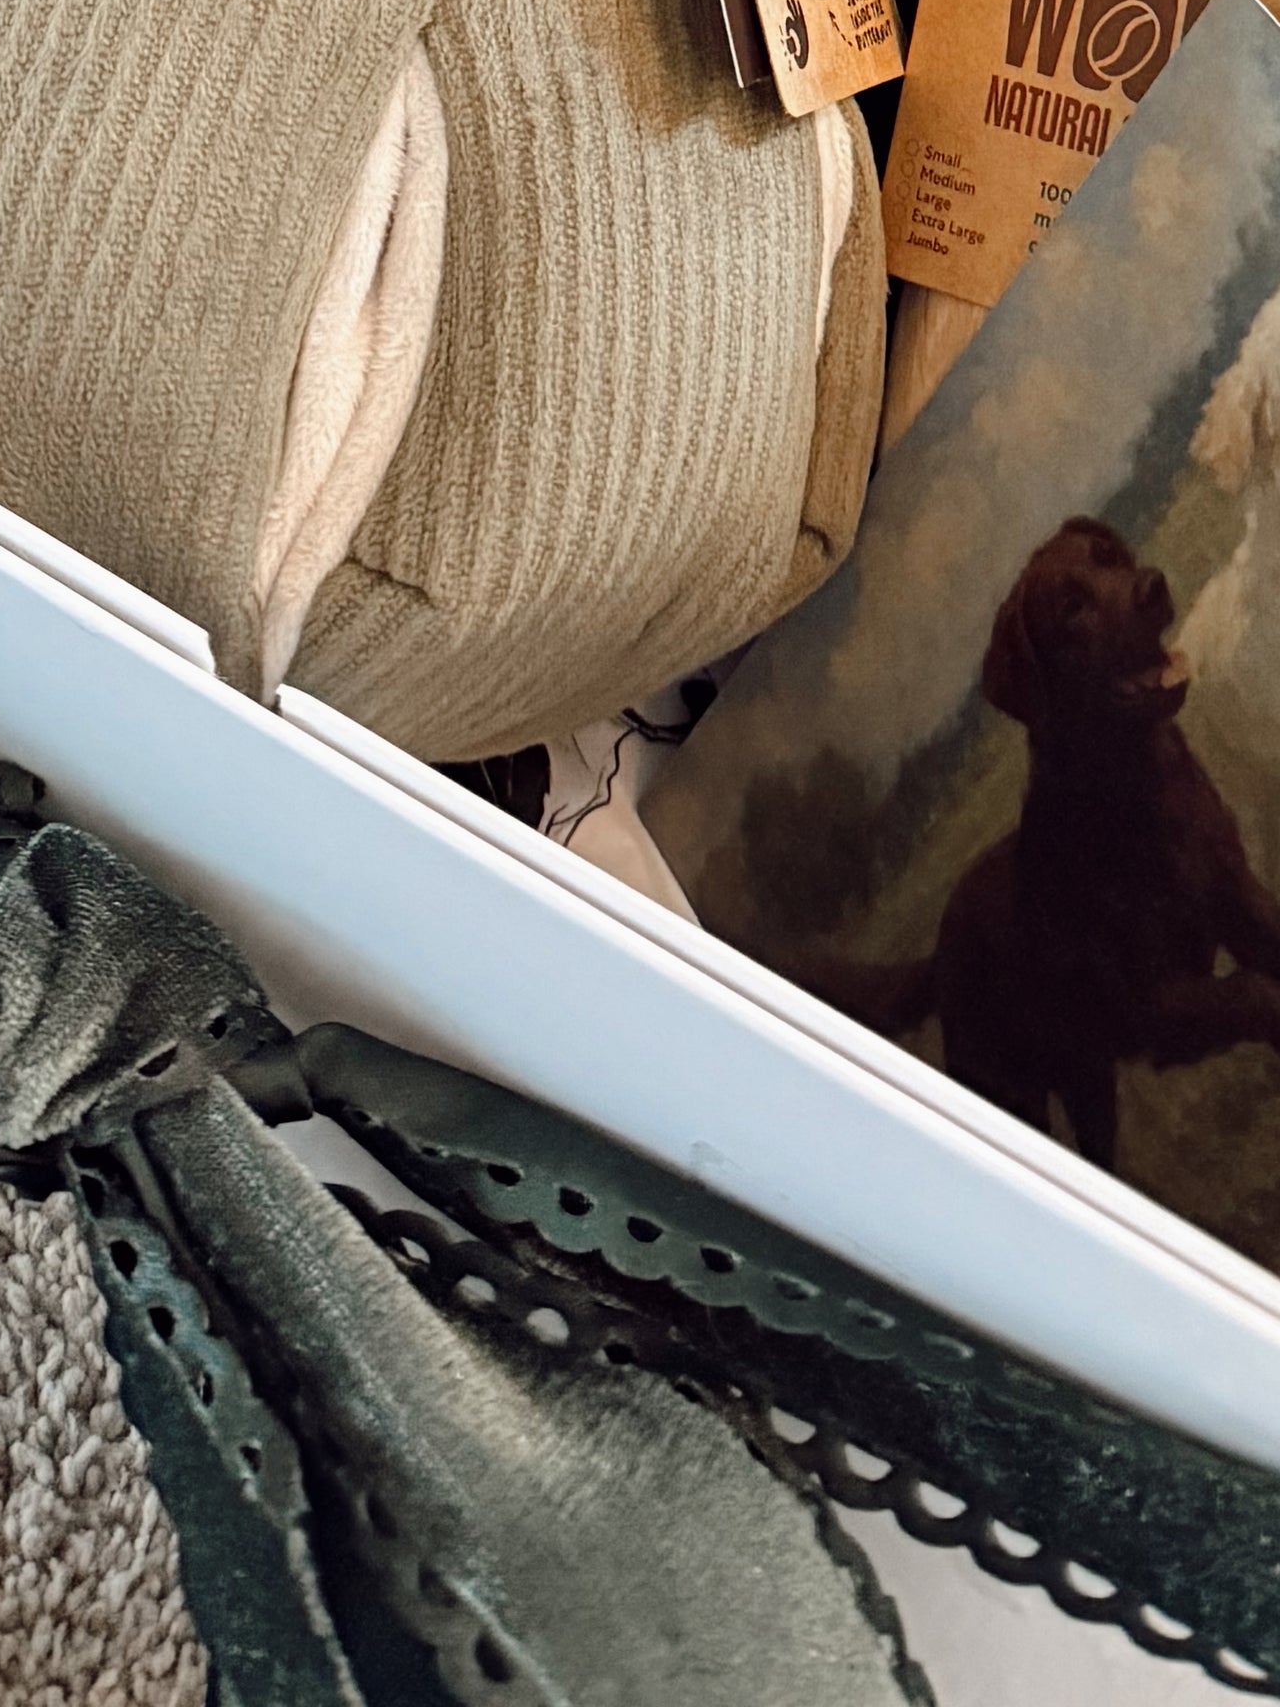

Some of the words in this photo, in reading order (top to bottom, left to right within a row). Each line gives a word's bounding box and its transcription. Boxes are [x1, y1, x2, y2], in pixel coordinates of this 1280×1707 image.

[924, 145, 962, 168] Small
[920, 165, 975, 195] Medium
[916, 187, 952, 211] Large
[911, 208, 946, 231] Extra
[949, 220, 985, 245] Large
[906, 231, 949, 255] Jumbo
